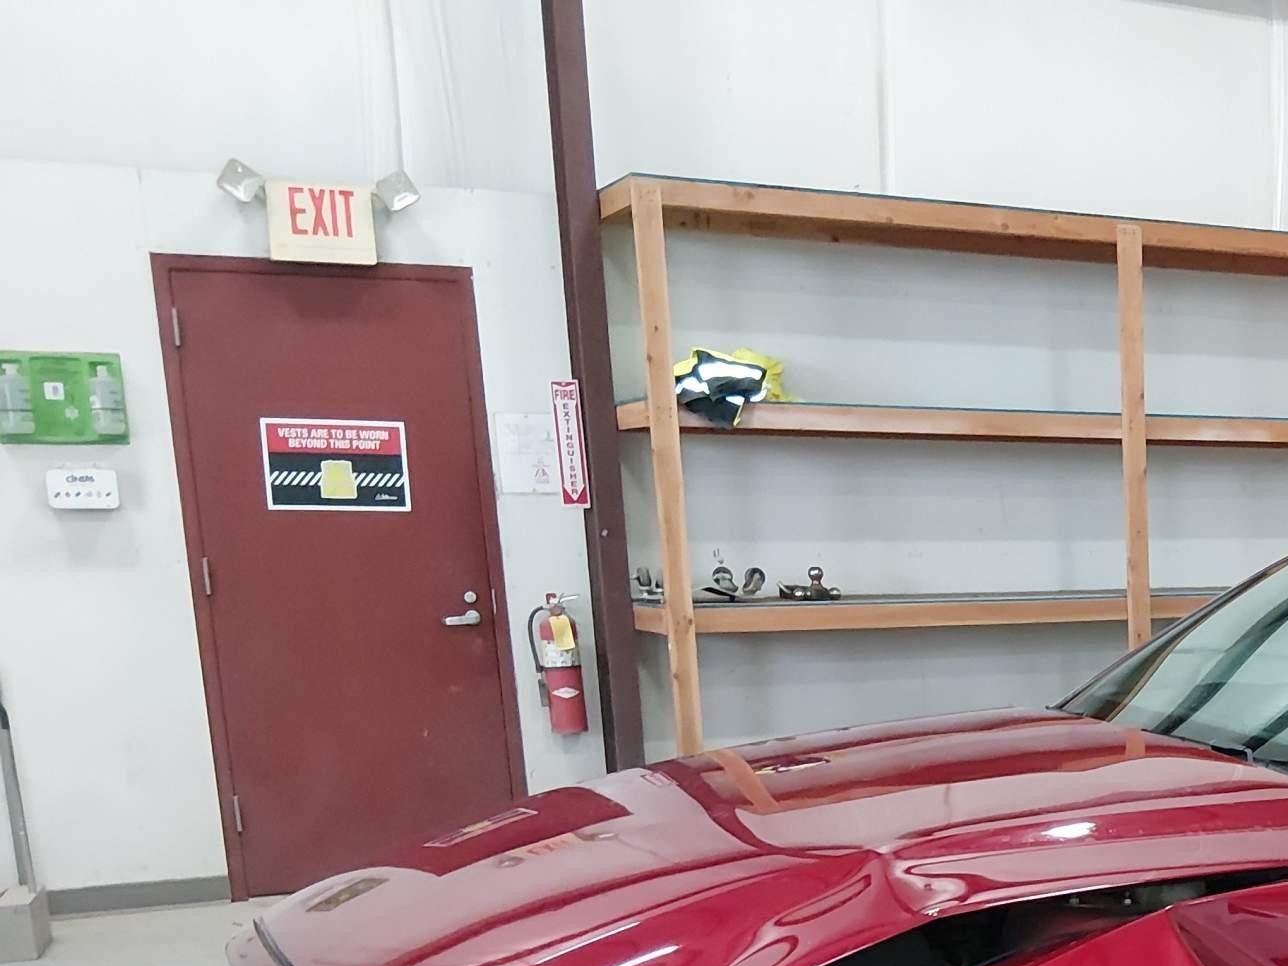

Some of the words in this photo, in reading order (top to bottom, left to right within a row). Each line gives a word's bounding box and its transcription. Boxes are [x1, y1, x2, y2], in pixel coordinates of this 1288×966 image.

[288, 187, 354, 238] EXIT
[554, 389, 575, 400] FIRE
[278, 428, 308, 438] VESTS
[310, 429, 329, 438] ARE
[331, 429, 343, 438] TO
[345, 430, 358, 439] BE
[359, 430, 389, 440] WORN
[288, 438, 327, 448] BEYOND
[330, 439, 350, 449] THIS
[353, 440, 381, 450] POINT
[562, 403, 578, 495] EXTINGUISHER
